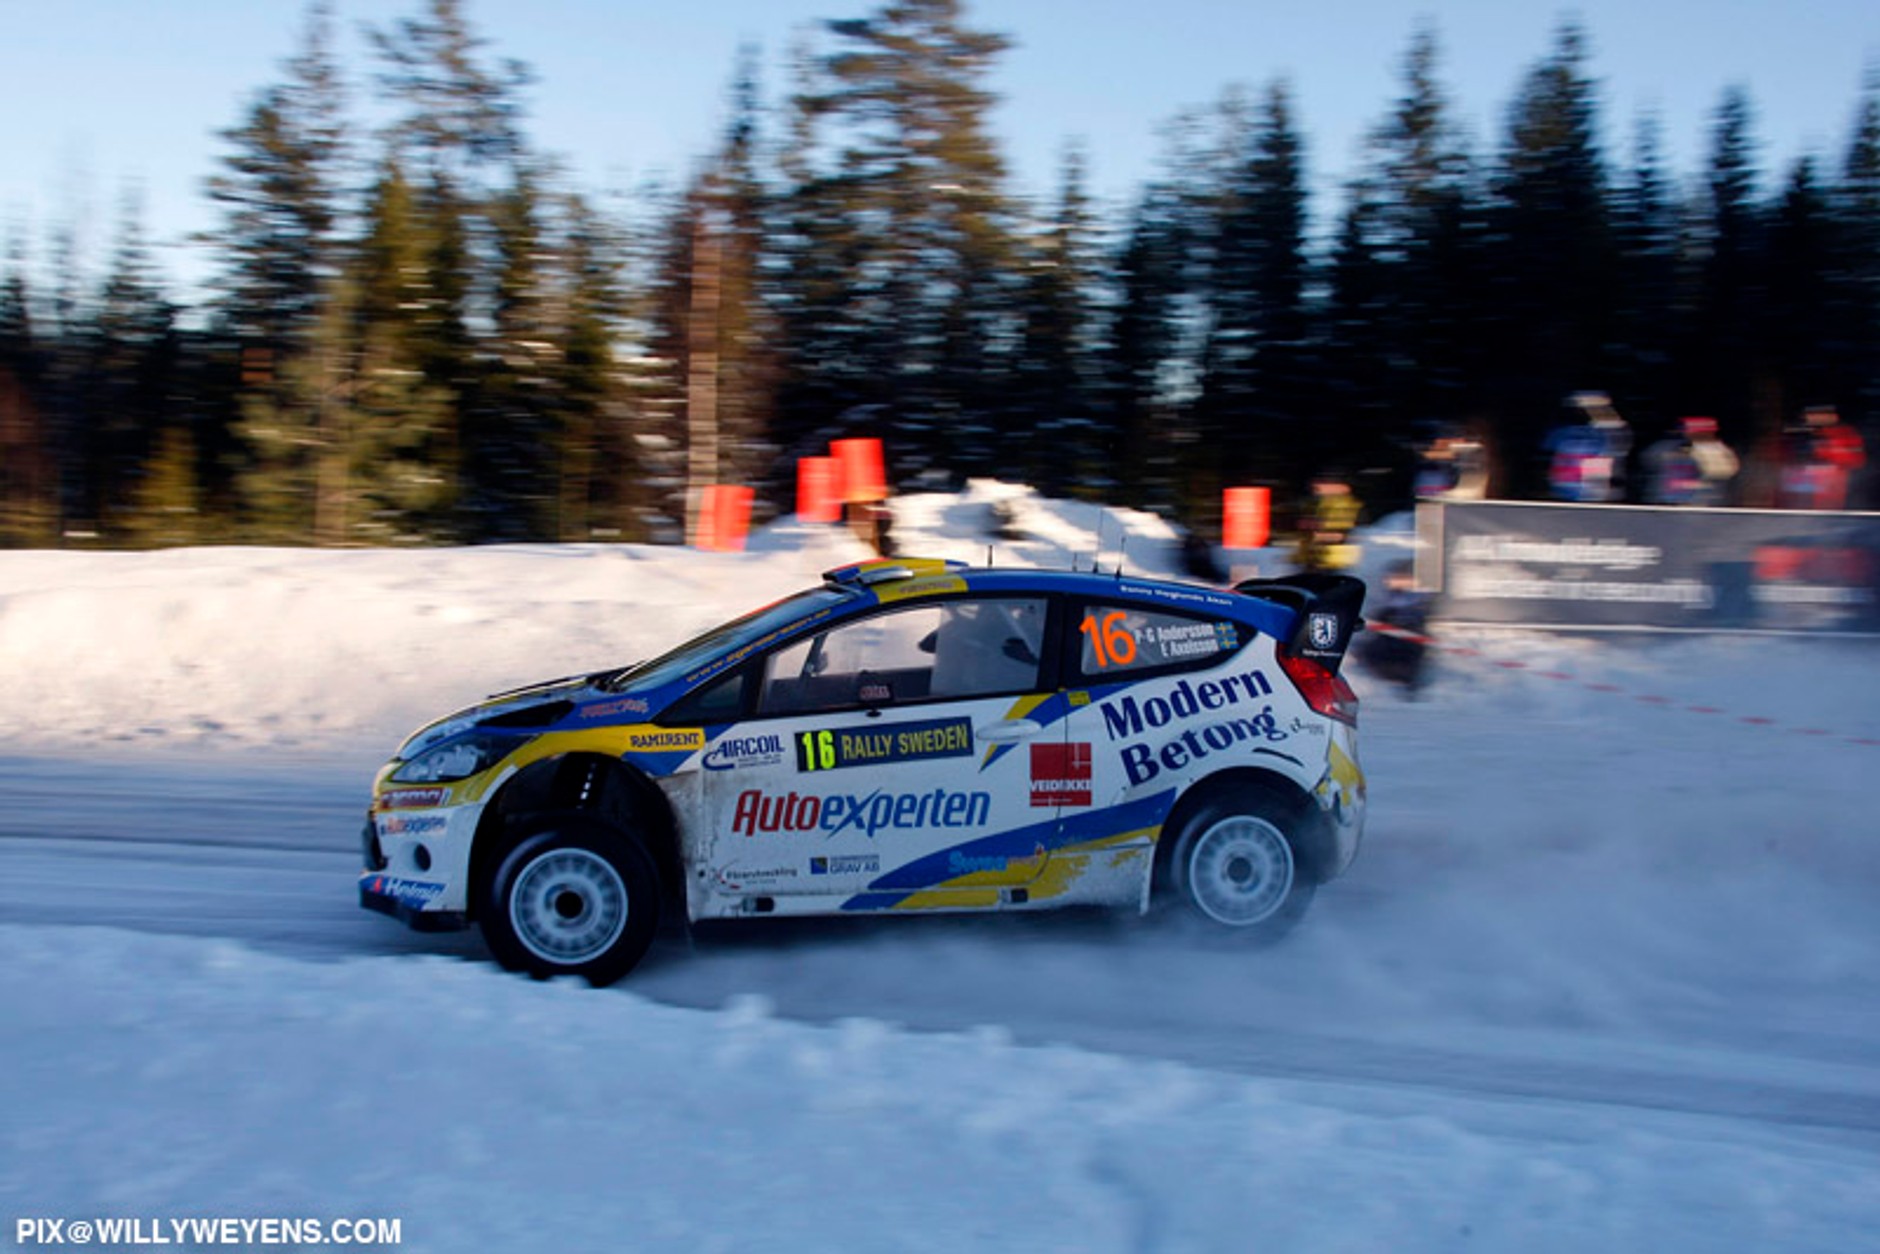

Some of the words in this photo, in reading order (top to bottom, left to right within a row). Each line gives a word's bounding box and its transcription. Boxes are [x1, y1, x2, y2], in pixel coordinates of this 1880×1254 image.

[1079, 611, 1136, 667] 16
[1100, 669, 1273, 741] Modern
[630, 733, 700, 748] RAMIRENT
[705, 735, 785, 762] AIRCOIL
[802, 730, 835, 771] 16
[841, 732, 893, 760] RALLY
[898, 723, 968, 753] SWEDEN
[1120, 705, 1288, 786] Betong
[732, 788, 991, 839] Autoexperten
